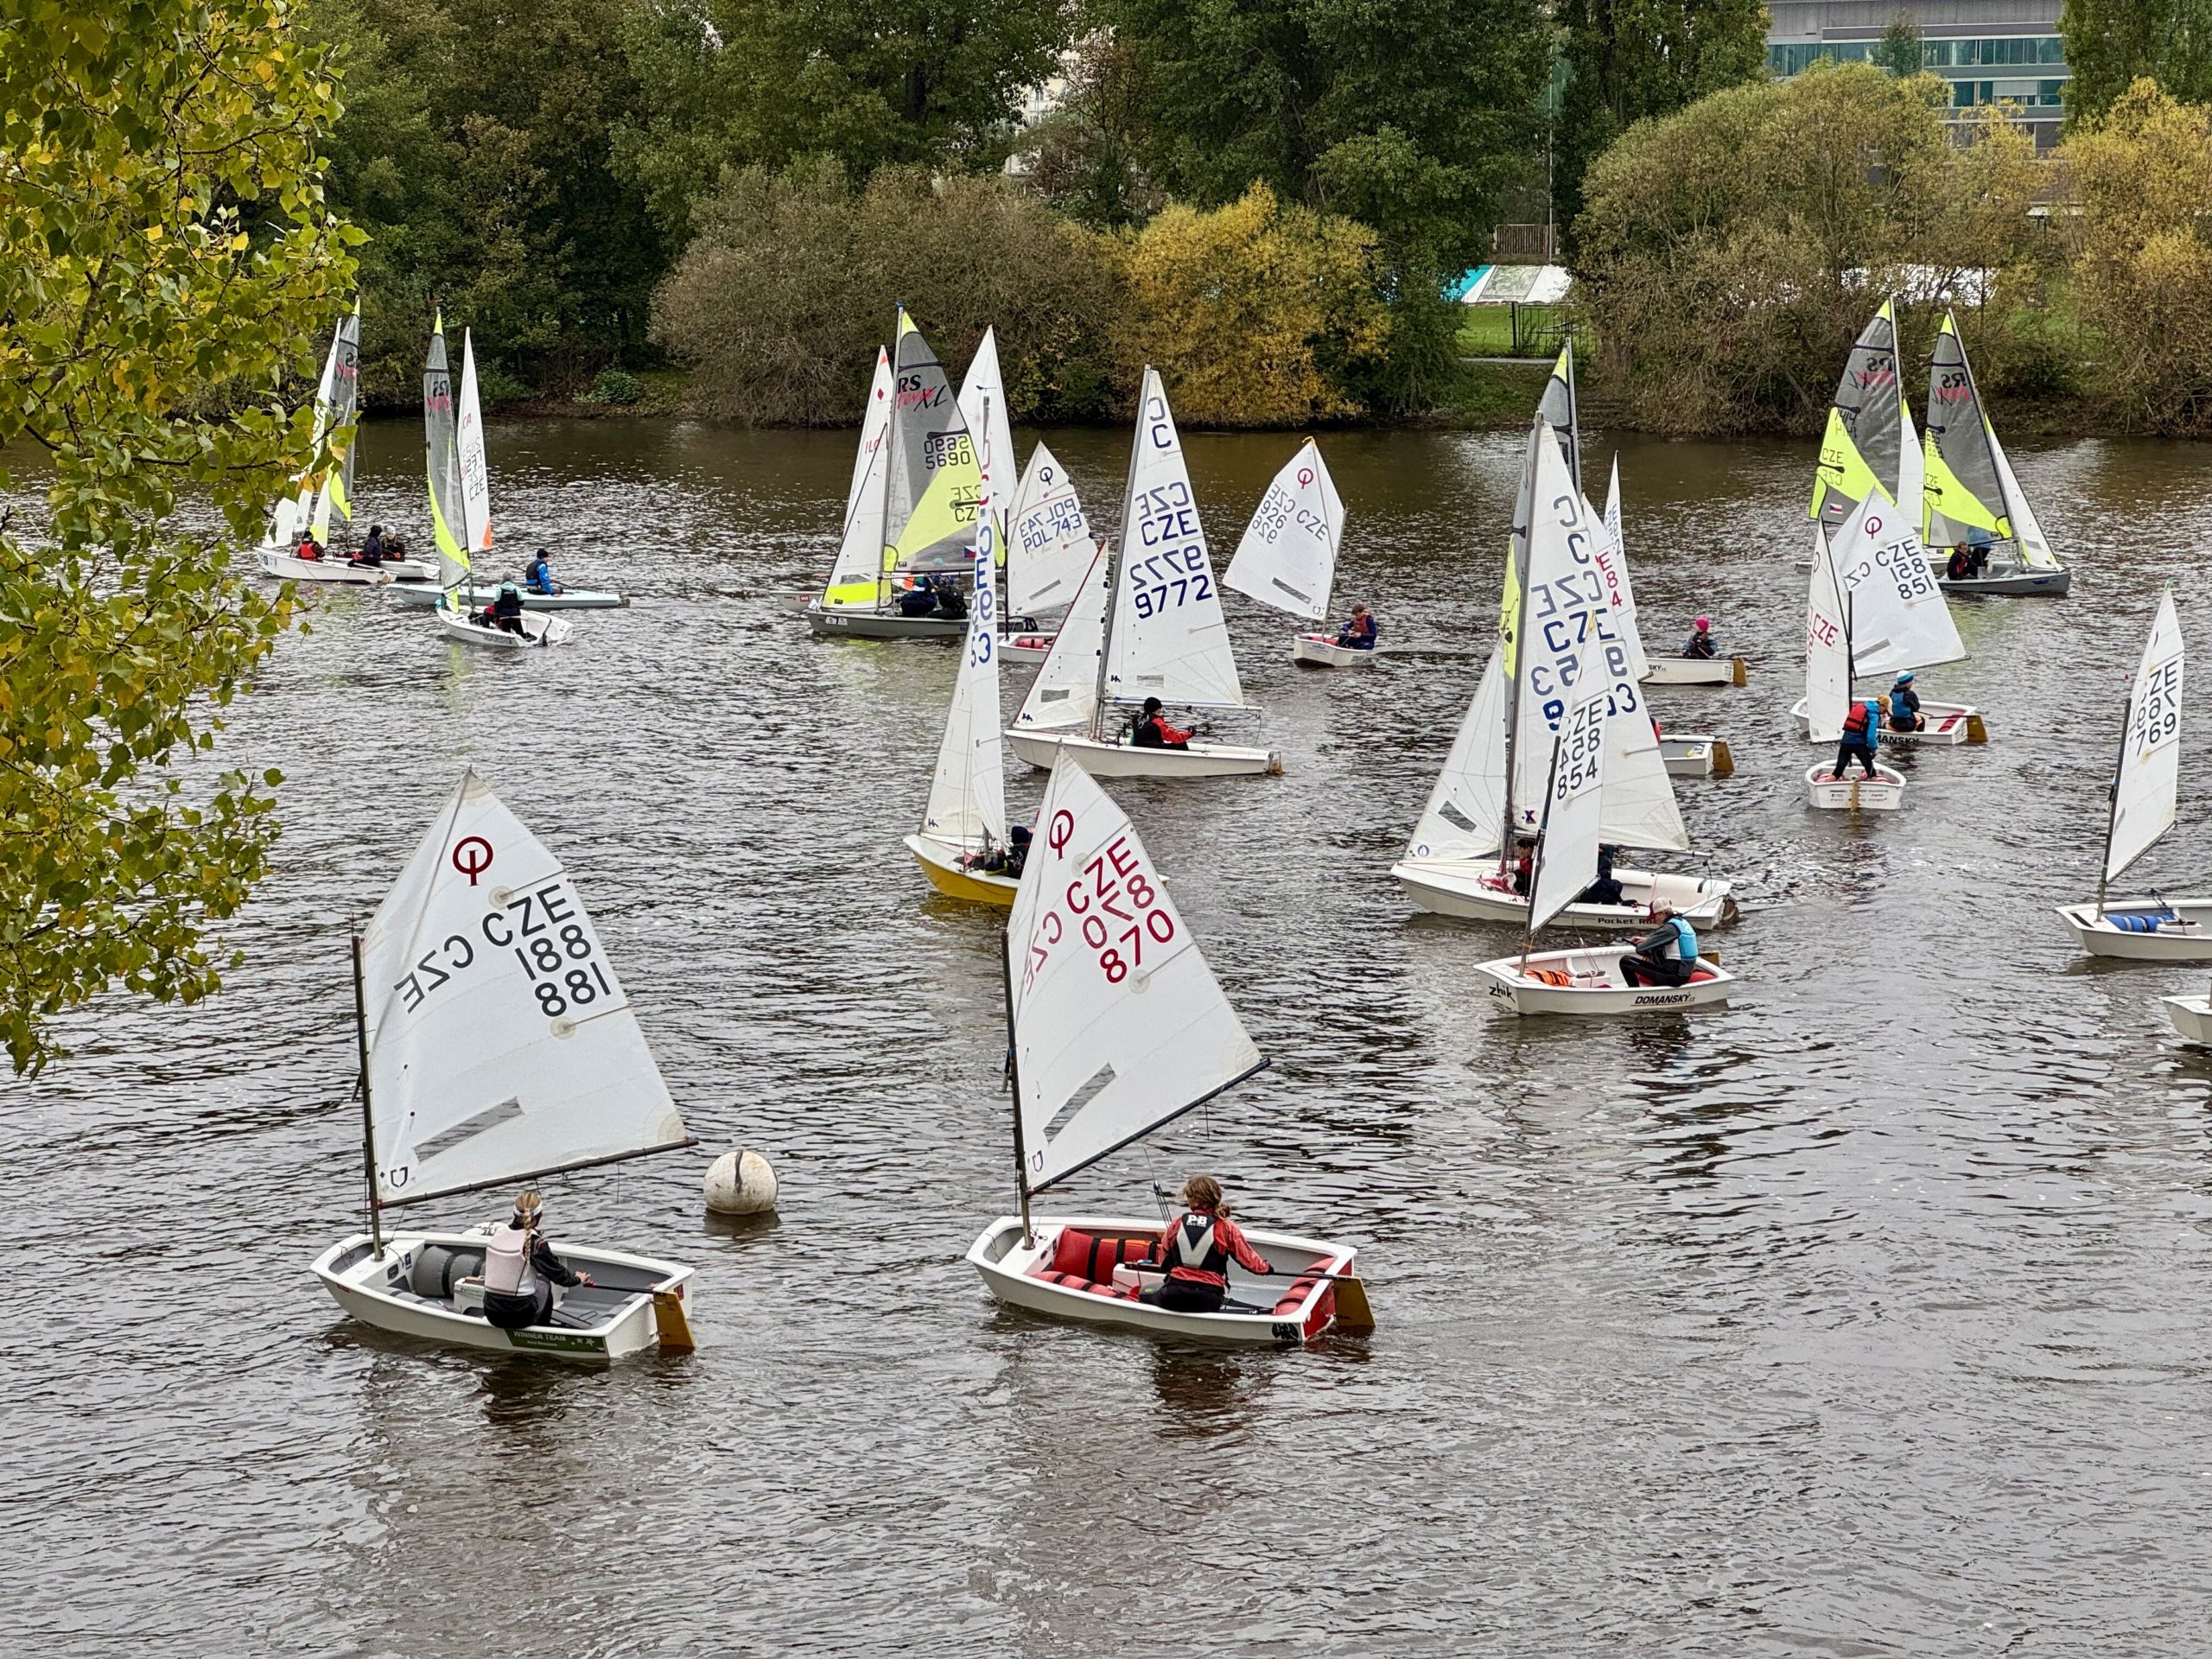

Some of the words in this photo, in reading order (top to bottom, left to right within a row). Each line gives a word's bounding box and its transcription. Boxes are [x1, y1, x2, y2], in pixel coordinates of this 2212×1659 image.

[898, 374, 921, 394] RS
[1152, 423, 1172, 448] C
[925, 451, 971, 470] 5690
[1821, 448, 1844, 465] CZE
[954, 505, 978, 523] CZ
[1141, 508, 1198, 546] CZE
[1261, 499, 1287, 529] 926
[1296, 509, 1328, 541] CZE
[1023, 529, 1052, 554] POL
[1052, 513, 1082, 537] 743
[1567, 533, 1590, 564] C
[1875, 539, 1920, 567] CZE
[1135, 575, 1212, 620] 9772
[1897, 575, 1935, 600] 851
[1813, 613, 1839, 647] CZE
[2136, 712, 2177, 757] 769
[1557, 755, 1598, 800] 854
[1066, 836, 1140, 915] CZE
[482, 884, 577, 948] CZE
[1099, 908, 1175, 984] 870
[535, 961, 612, 1018] 881
[513, 1331, 544, 1340] WINNER
[545, 1333, 567, 1342] TEAM
